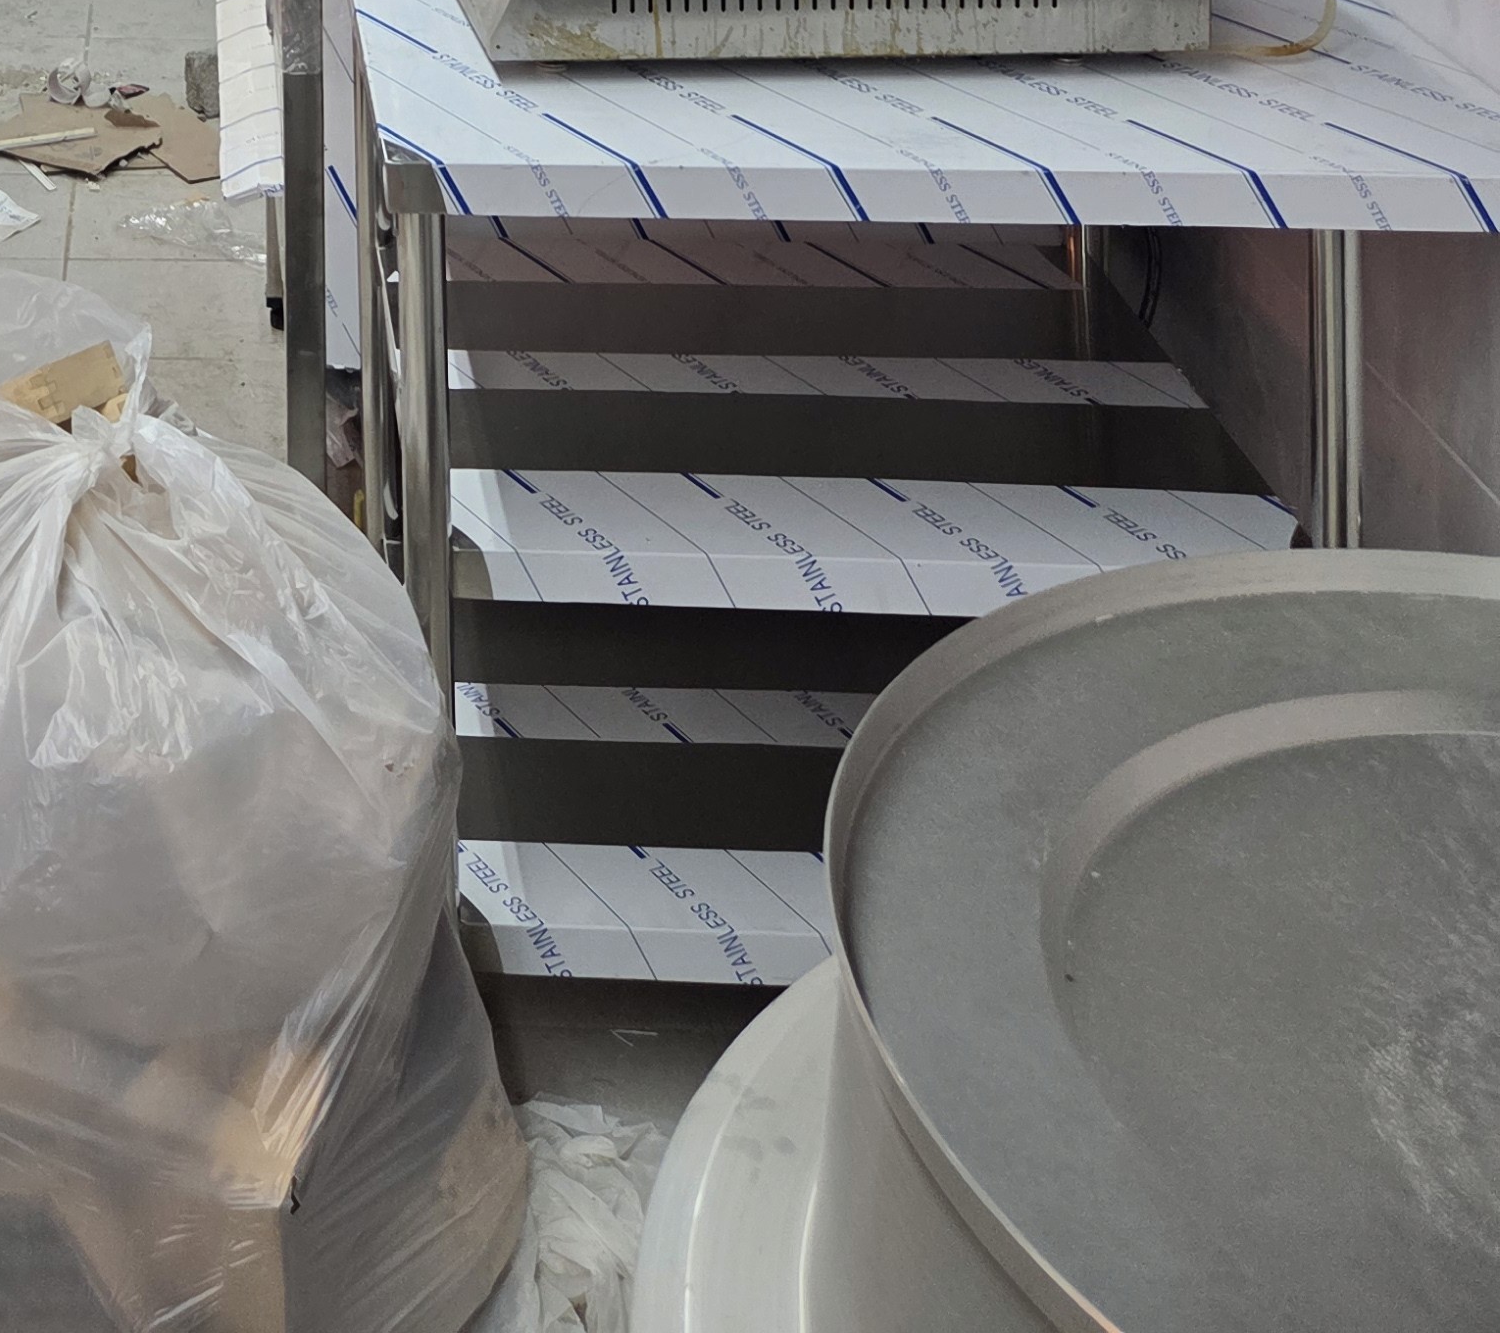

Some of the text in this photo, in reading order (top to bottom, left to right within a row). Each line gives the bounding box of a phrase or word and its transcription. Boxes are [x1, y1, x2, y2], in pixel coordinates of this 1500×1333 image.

[434, 53, 539, 113] STAINLESS STEEL
[1065, 96, 1118, 119] STEEL
[1163, 61, 1315, 122] STAINLESS STEEL
[1351, 64, 1453, 103] STAINLESS
[538, 493, 649, 605] STAINLESS STEEL
[723, 499, 843, 613] STAINLESS STEEL
[912, 502, 1028, 597] AINLESS STEEL
[1102, 507, 1157, 542] STEEL
[466, 855, 572, 978] STAINLESS STEEL
[648, 861, 763, 986] STAINLESS STEEL
